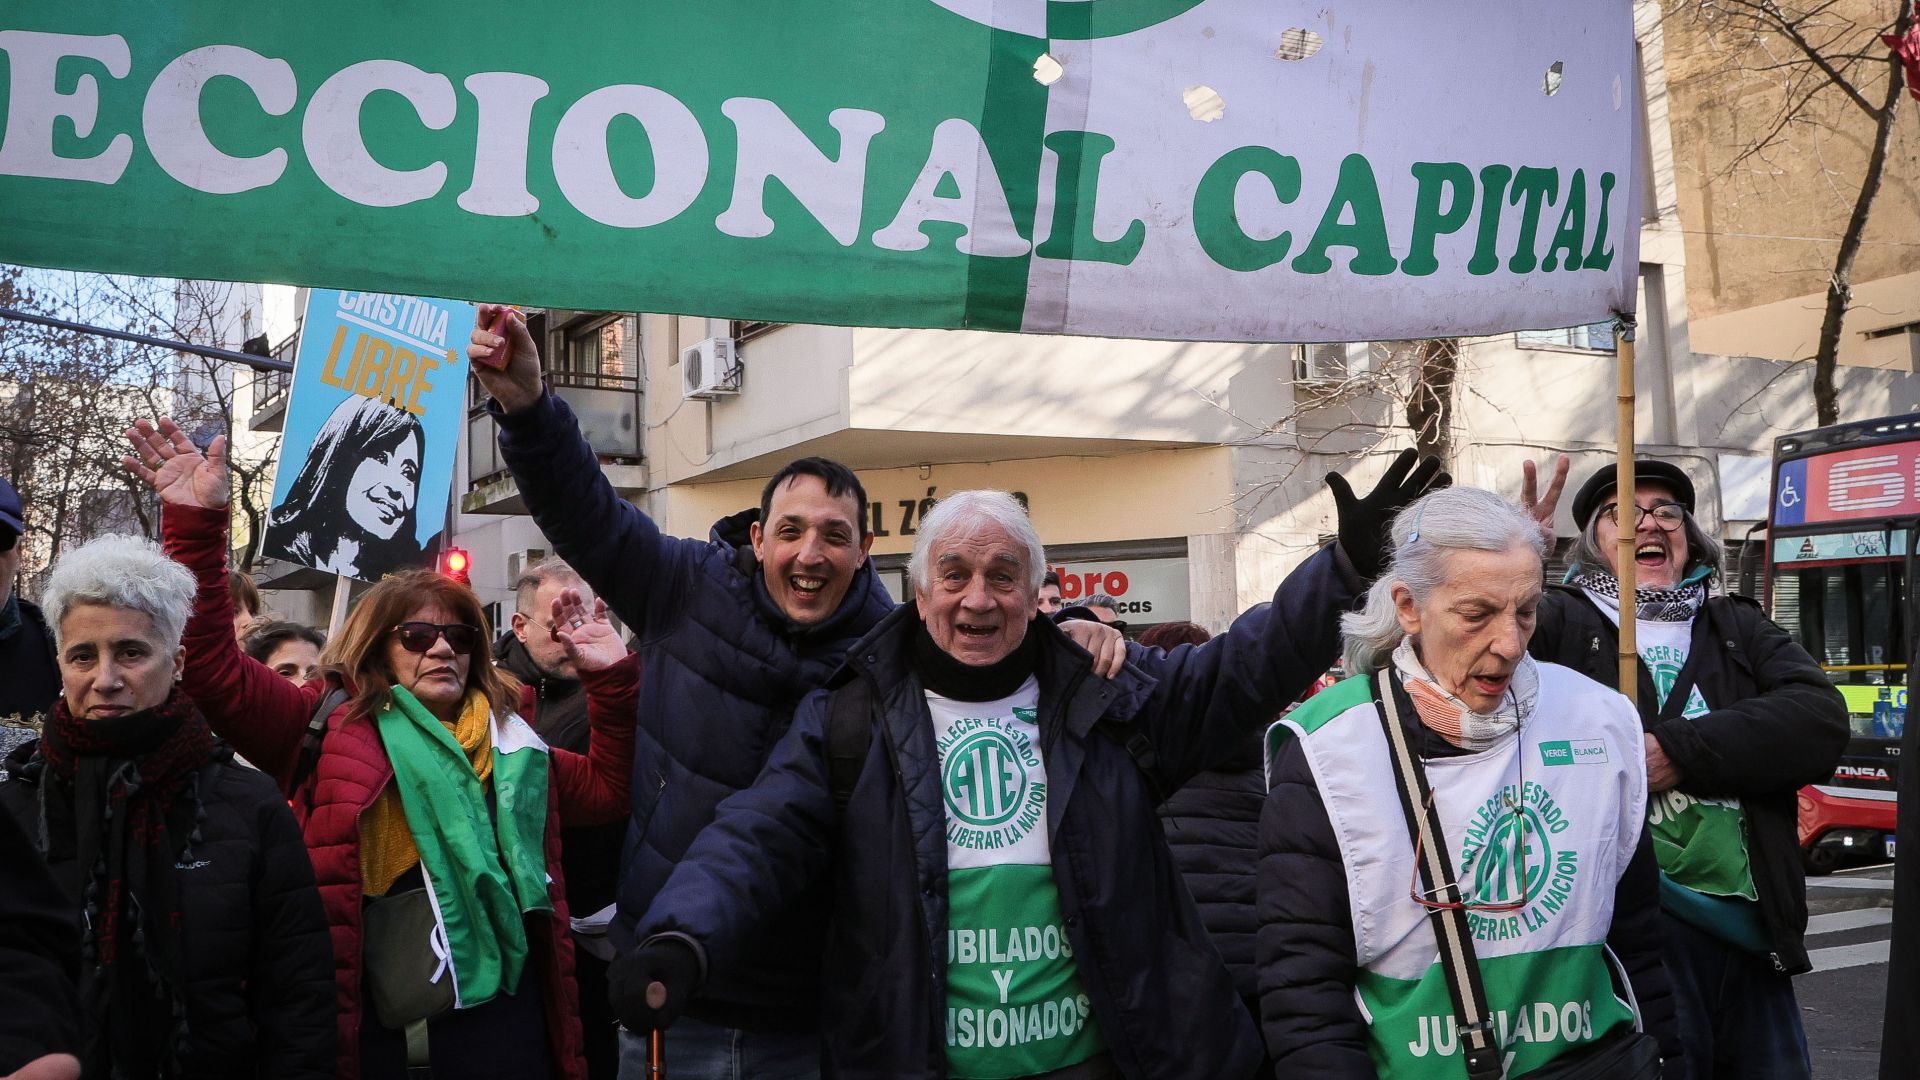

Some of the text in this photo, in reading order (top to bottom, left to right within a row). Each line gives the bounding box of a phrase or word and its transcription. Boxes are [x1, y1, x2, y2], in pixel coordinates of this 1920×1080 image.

[0, 30, 1616, 276] ECCIONAL CAPITAL
[338, 290, 449, 347] CRISTINA
[320, 325, 440, 417] LIBRE
[1828, 454, 1920, 512] 6
[1855, 543, 1878, 556] CAR
[1047, 565, 1129, 599] bro
[987, 718, 1001, 730] EL
[1004, 722, 1040, 768] ESTADO
[1544, 746, 1605, 758] VERDE BLANCA
[950, 739, 1016, 816] ATE
[1003, 824, 1024, 846] LA
[1016, 781, 1046, 834] NACION
[1522, 781, 1570, 834] ESTADO
[1466, 851, 1578, 941] BERAR LA NACION
[991, 969, 1014, 1004] Y
[1408, 1000, 1593, 1057] JULADOS
